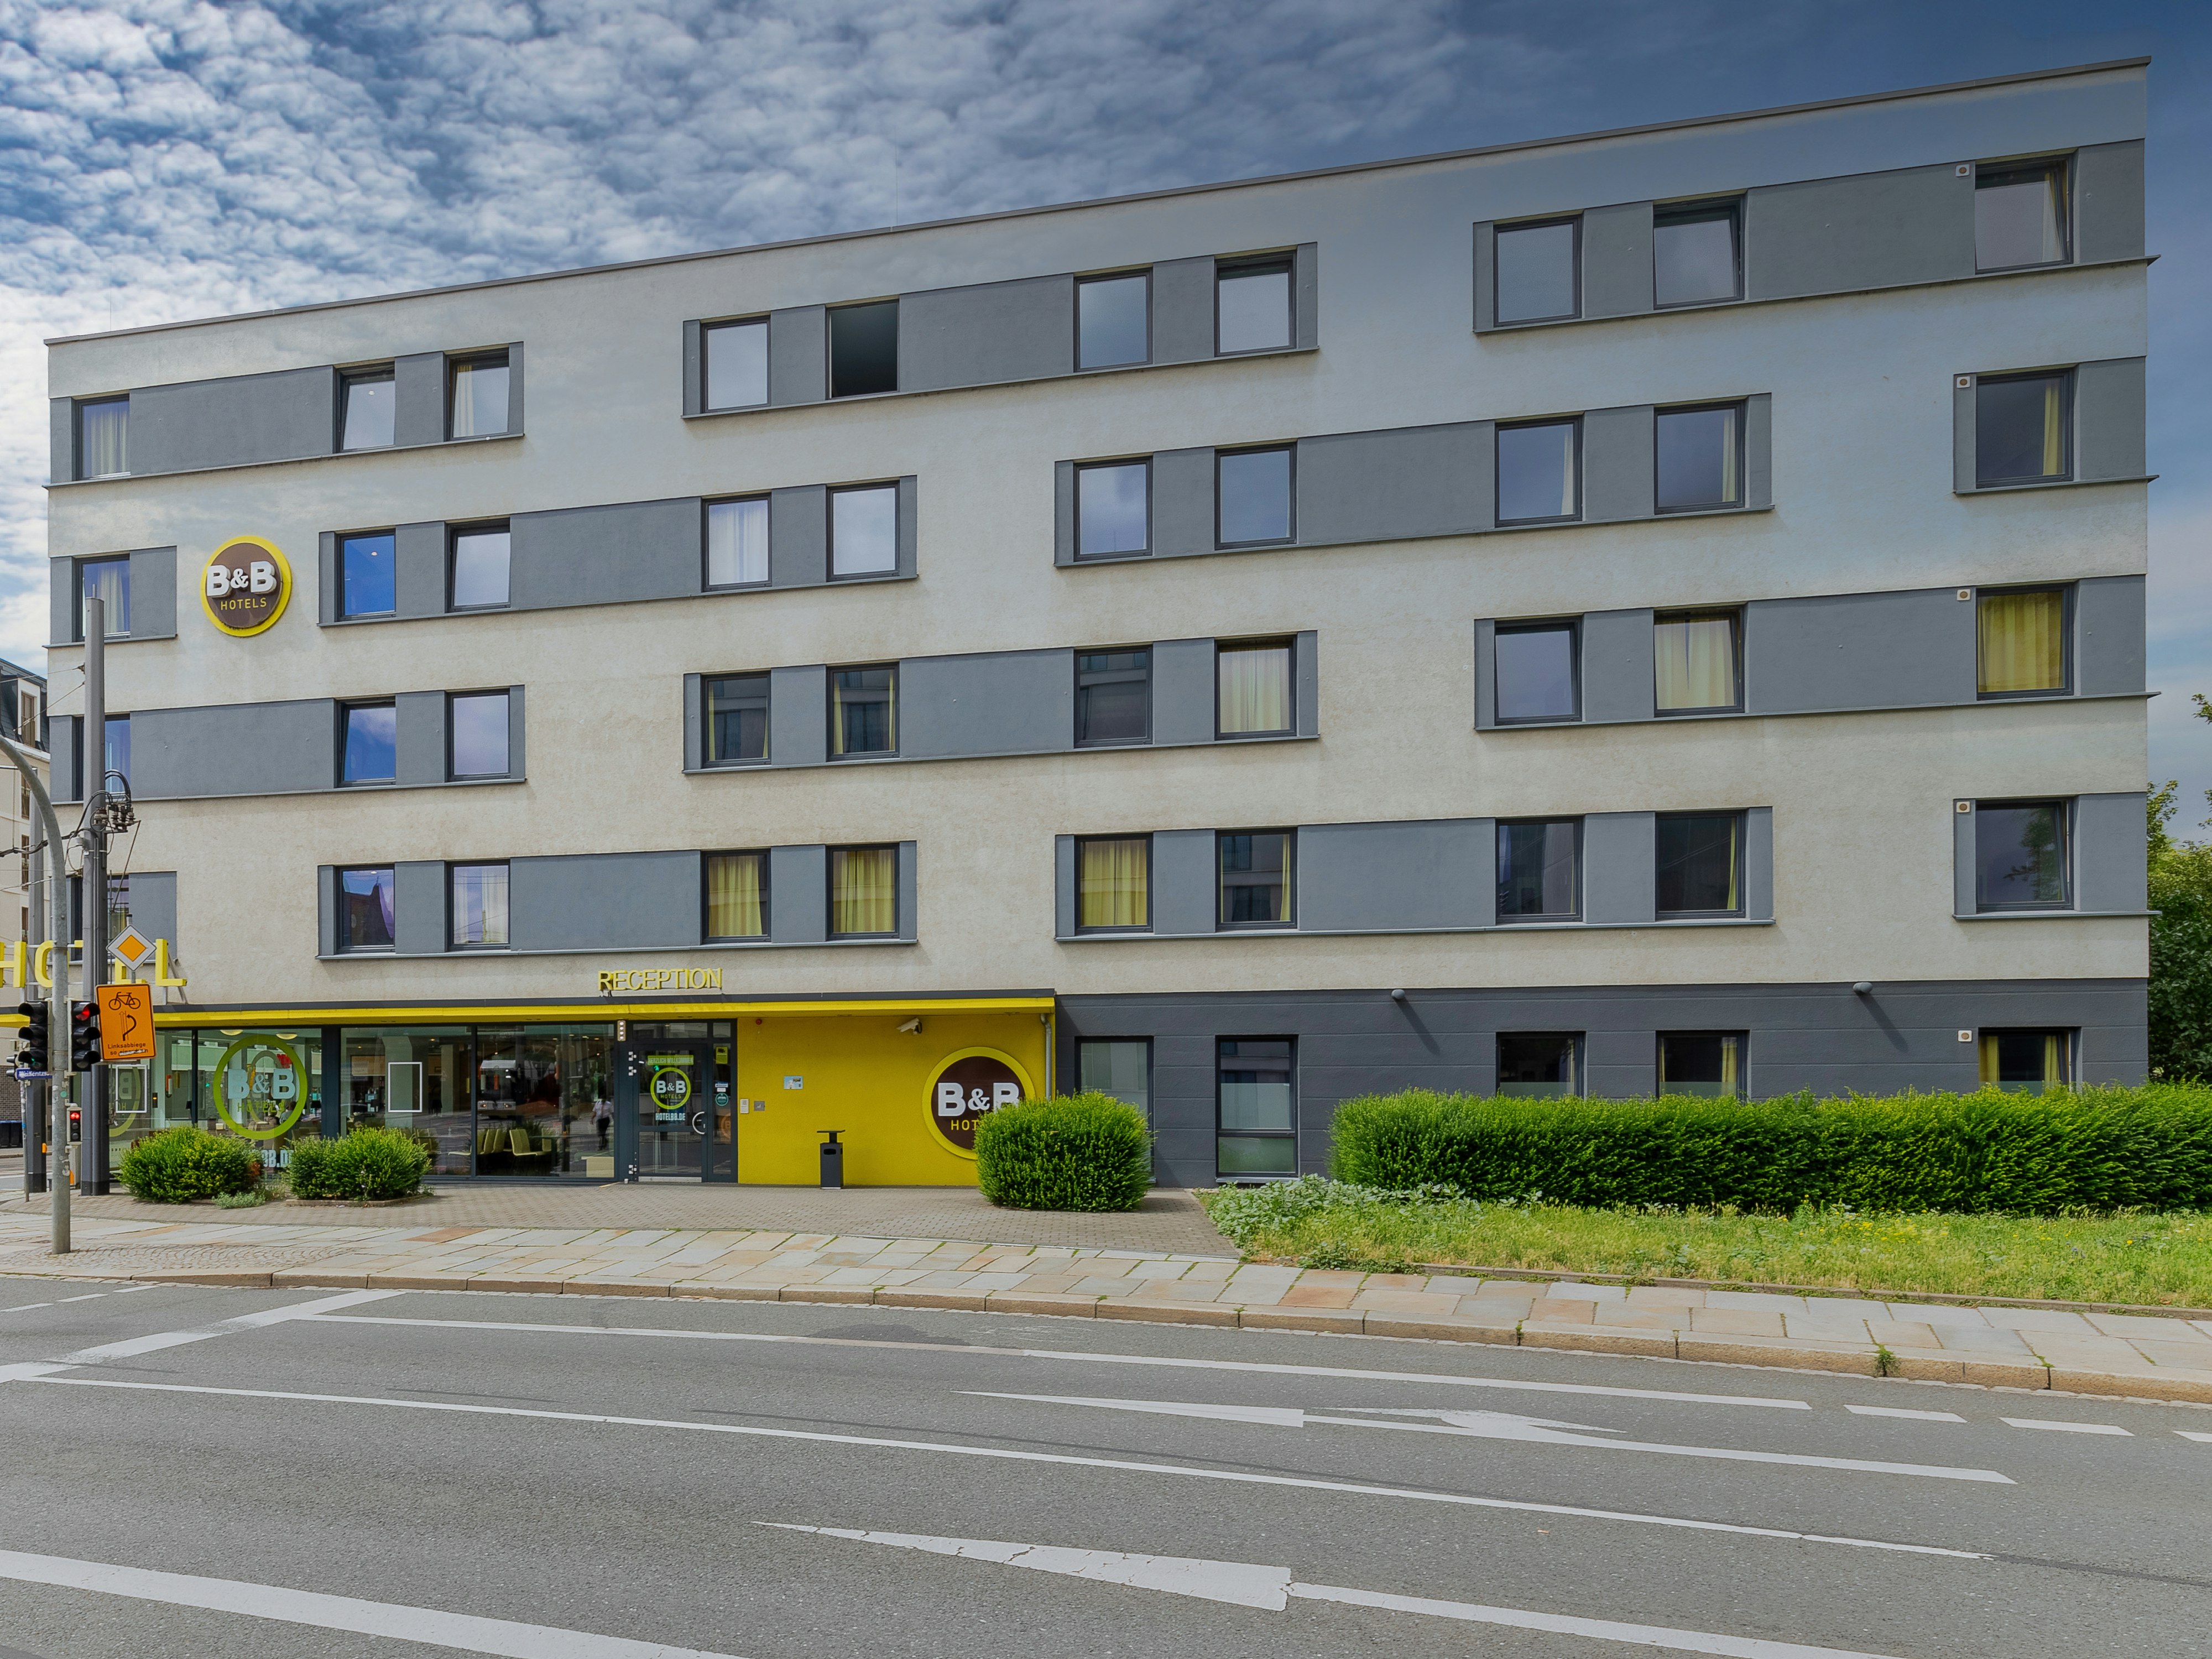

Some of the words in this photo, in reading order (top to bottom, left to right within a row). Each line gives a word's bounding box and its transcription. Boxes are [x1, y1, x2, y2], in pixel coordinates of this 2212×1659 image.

[206, 561, 276, 597] B&B
[221, 597, 267, 611] HOTELS
[0, 938, 187, 988] HOEL
[598, 967, 722, 991] RECEPTION
[228, 1068, 295, 1099] B&B
[656, 1081, 686, 1093] B&B
[237, 1100, 285, 1113] HOTELS
[938, 1082, 1020, 1117] B&B
[655, 1113, 686, 1121] HOTELBB.DE
[951, 1119, 980, 1131] HOT
